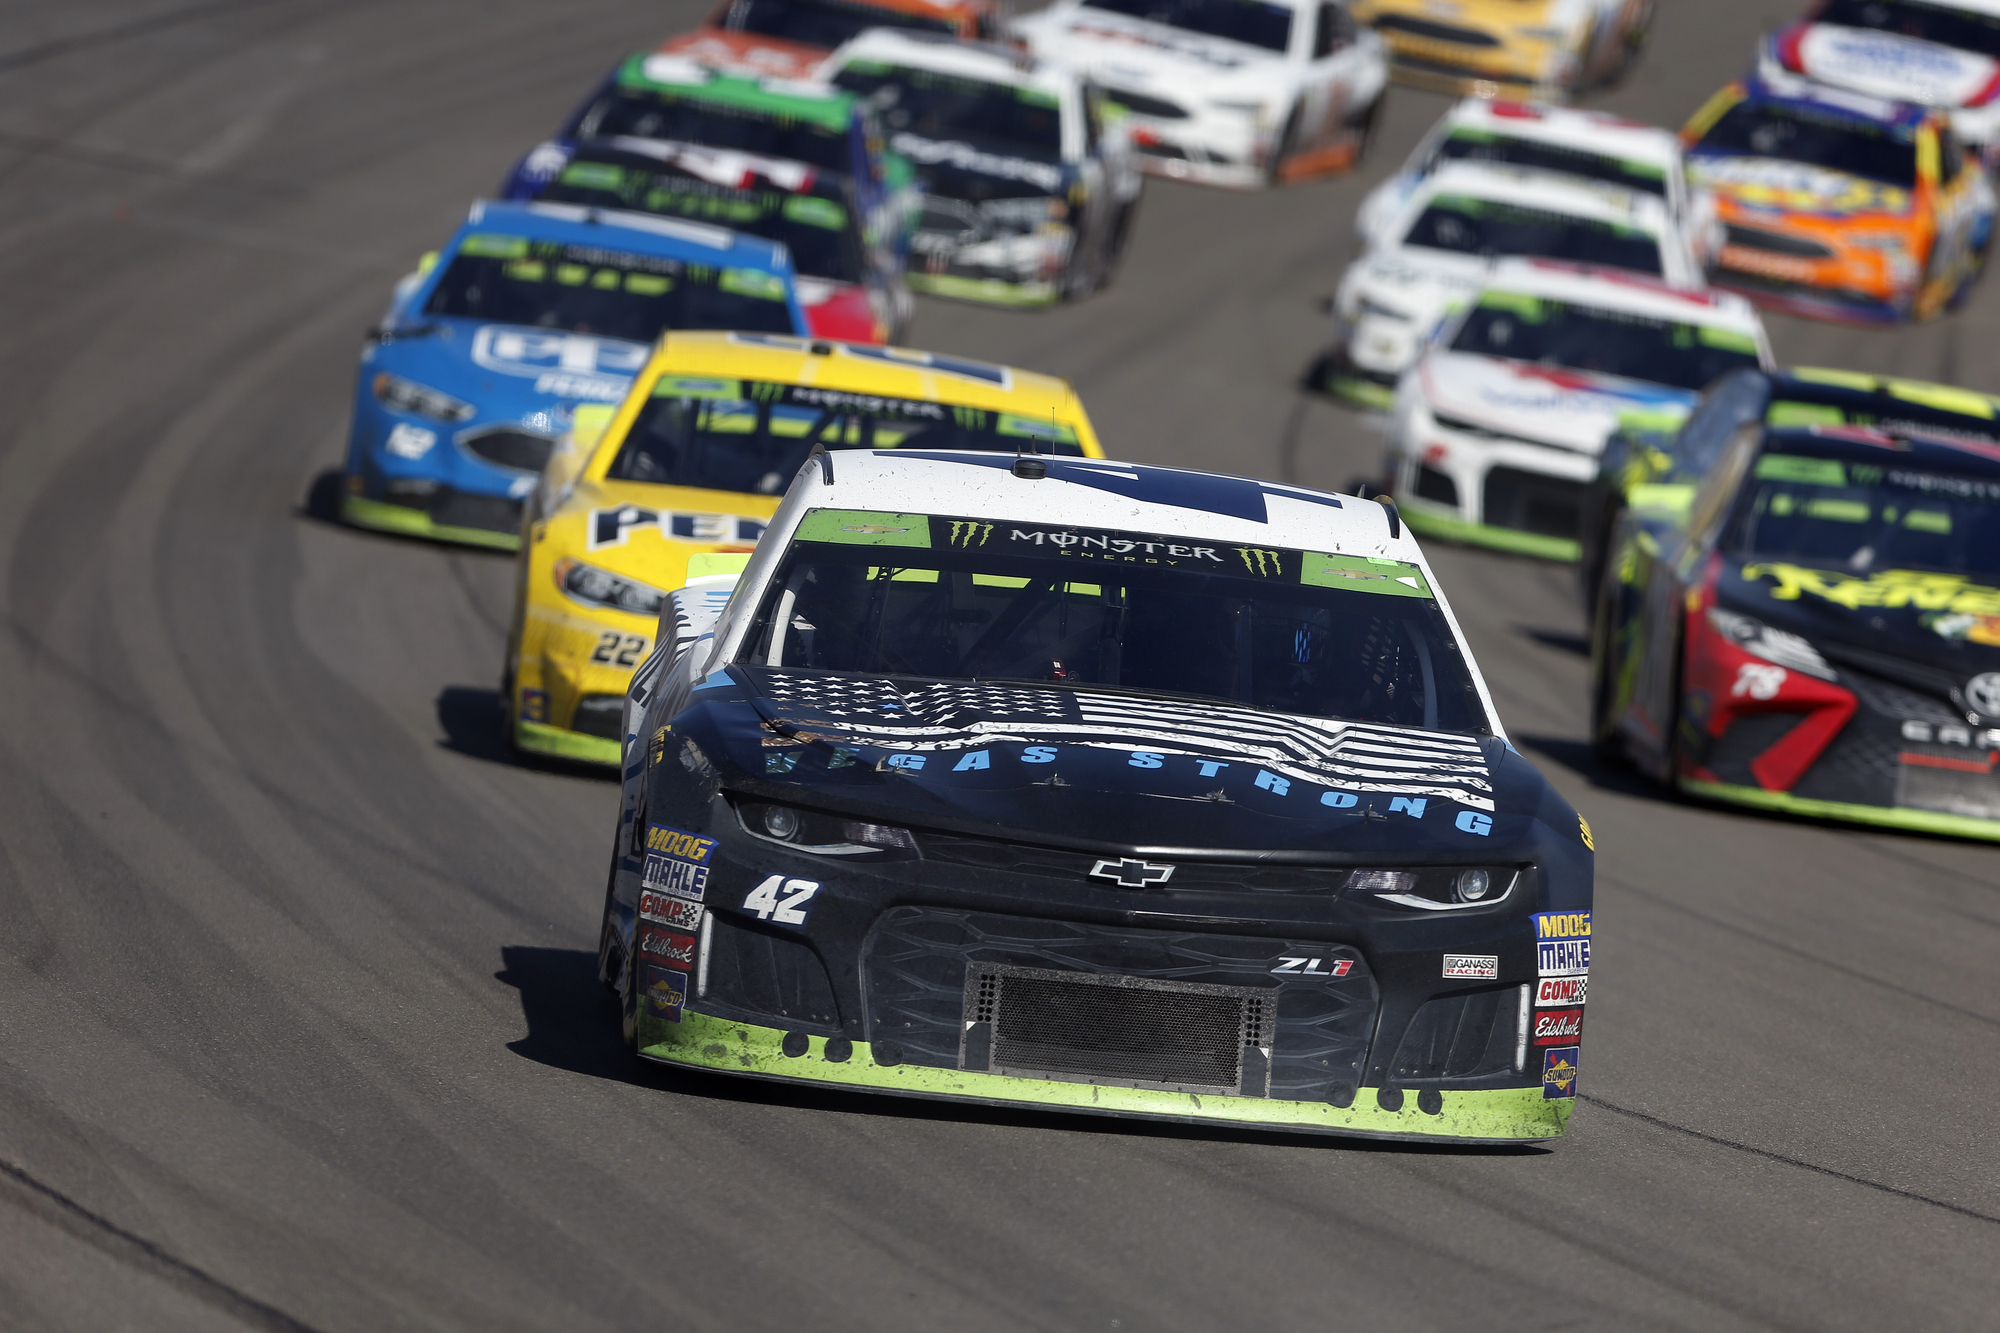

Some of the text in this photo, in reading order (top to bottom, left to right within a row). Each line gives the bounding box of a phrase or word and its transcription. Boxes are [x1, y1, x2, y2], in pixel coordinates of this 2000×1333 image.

[1010, 529, 1224, 562] MONSTER
[1061, 550, 1177, 566] ENERGY
[592, 633, 646, 669] 22
[1732, 662, 1788, 700] 78
[764, 746, 1494, 837] VEGAS STRONG
[646, 826, 713, 861] MOOG
[643, 855, 707, 895] MAHLE
[641, 895, 683, 918] COMP
[743, 874, 820, 925] 42
[666, 916, 690, 927] CAMS
[1539, 914, 1591, 938] MOOG
[641, 932, 693, 963] Edelbrock
[1540, 942, 1589, 969] MAHLE
[1270, 956, 1354, 977] ZL1
[1446, 968, 1494, 976] RACING
[1541, 980, 1577, 1001] COMP
[1568, 995, 1584, 1003] CAMS
[1534, 1015, 1581, 1038] Edelbrock
